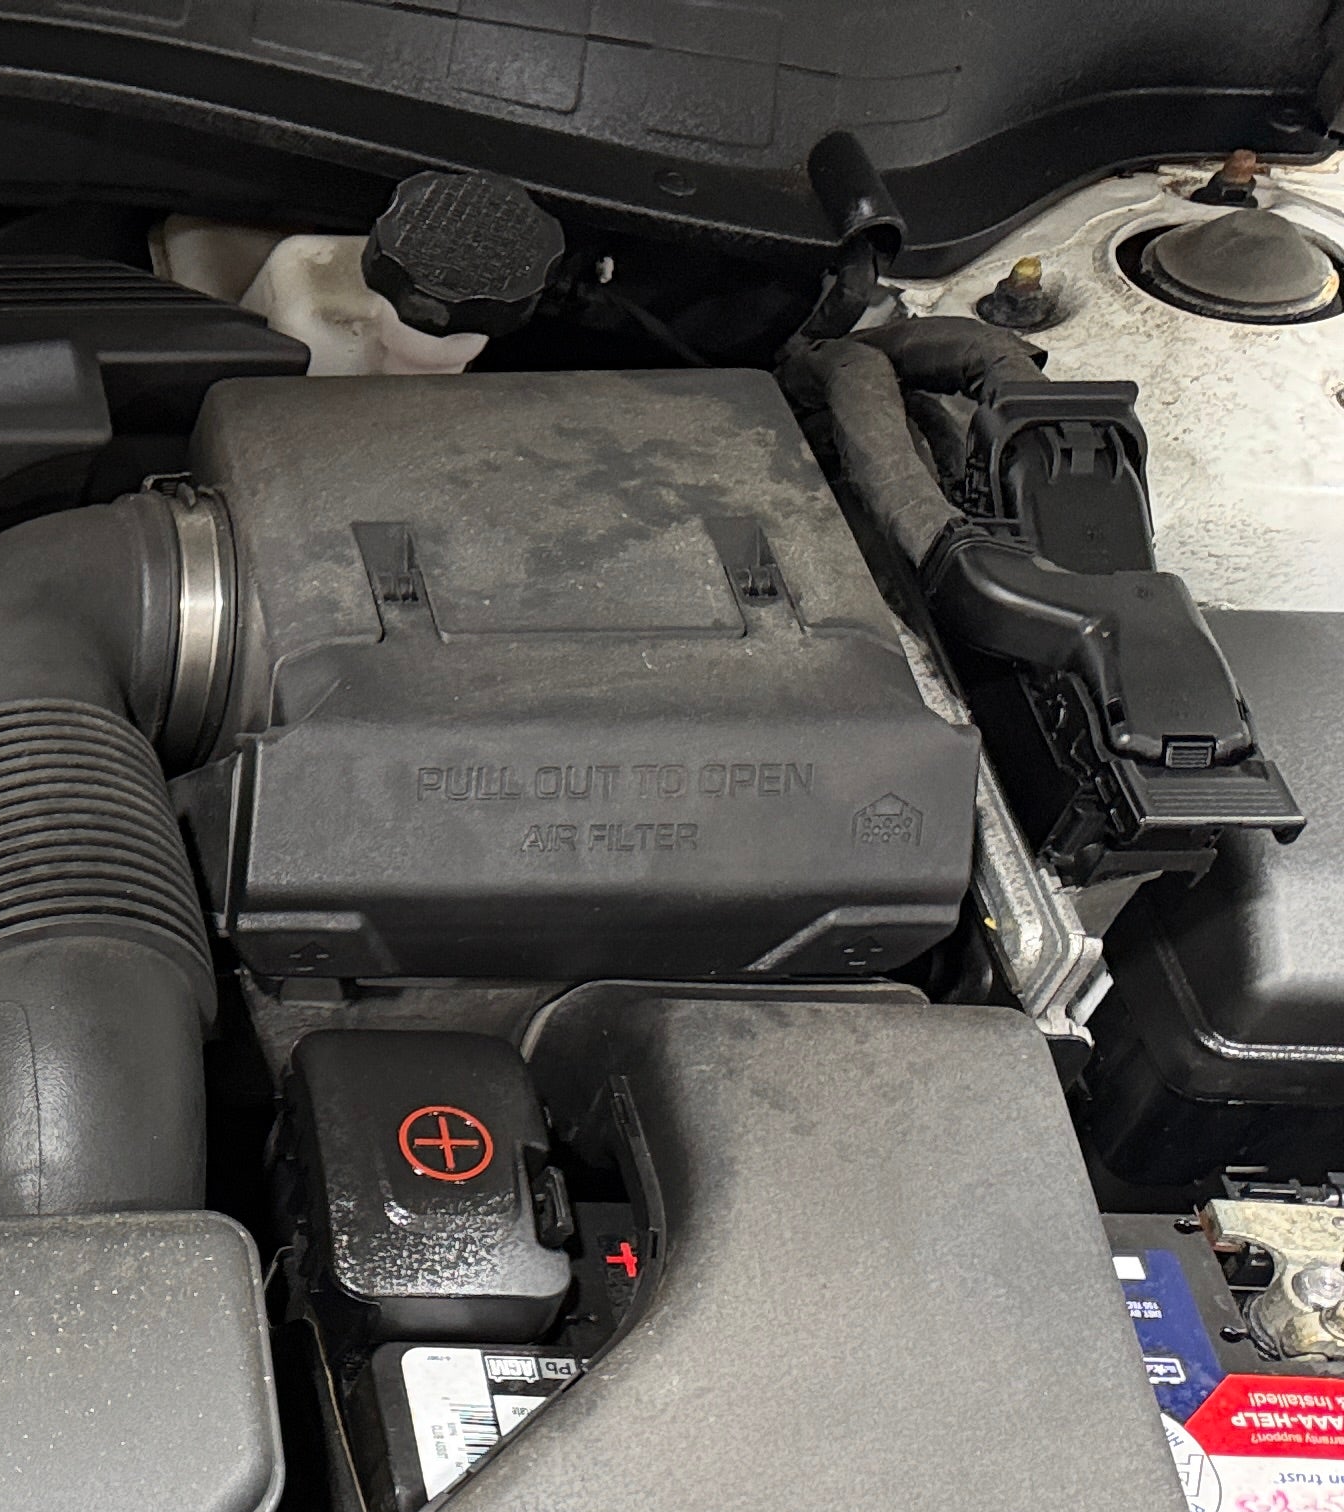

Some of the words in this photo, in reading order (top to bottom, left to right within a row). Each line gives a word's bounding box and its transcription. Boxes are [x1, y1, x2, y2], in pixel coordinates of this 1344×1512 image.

[417, 766, 521, 801] PULL
[535, 765, 620, 800] OUT
[632, 763, 690, 799] TO
[699, 762, 813, 799] OPEN
[520, 823, 578, 852] AIR
[588, 822, 699, 852] FILTER
[489, 1358, 534, 1377] AGM
[545, 1361, 572, 1376] Pb
[1247, 1391, 1334, 1411] Installed!
[1250, 1431, 1303, 1444] support?
